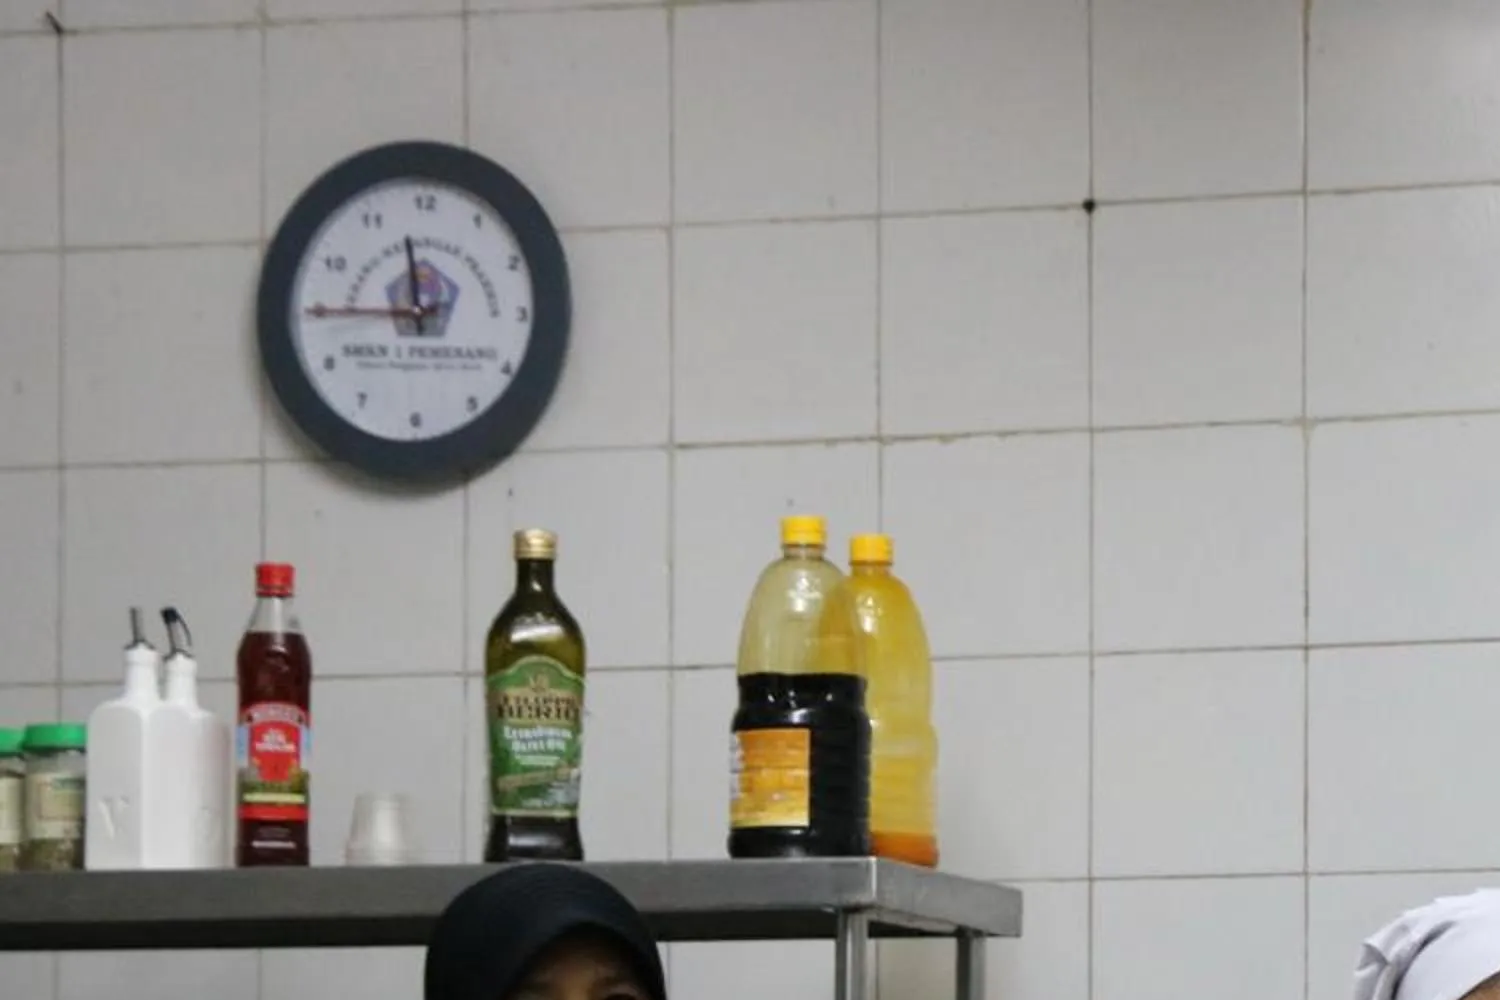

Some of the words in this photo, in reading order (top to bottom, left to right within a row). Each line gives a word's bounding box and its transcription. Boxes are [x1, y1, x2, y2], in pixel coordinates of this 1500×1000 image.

[414, 194, 437, 212] 12
[362, 213, 383, 229] 11
[473, 213, 483, 229] 1
[326, 254, 347, 272] 10
[508, 254, 521, 271] 2
[517, 305, 529, 323] 3
[501, 361, 513, 375] 4
[357, 391, 368, 409] 7
[466, 396, 478, 413] 5
[409, 412, 422, 429] 6
